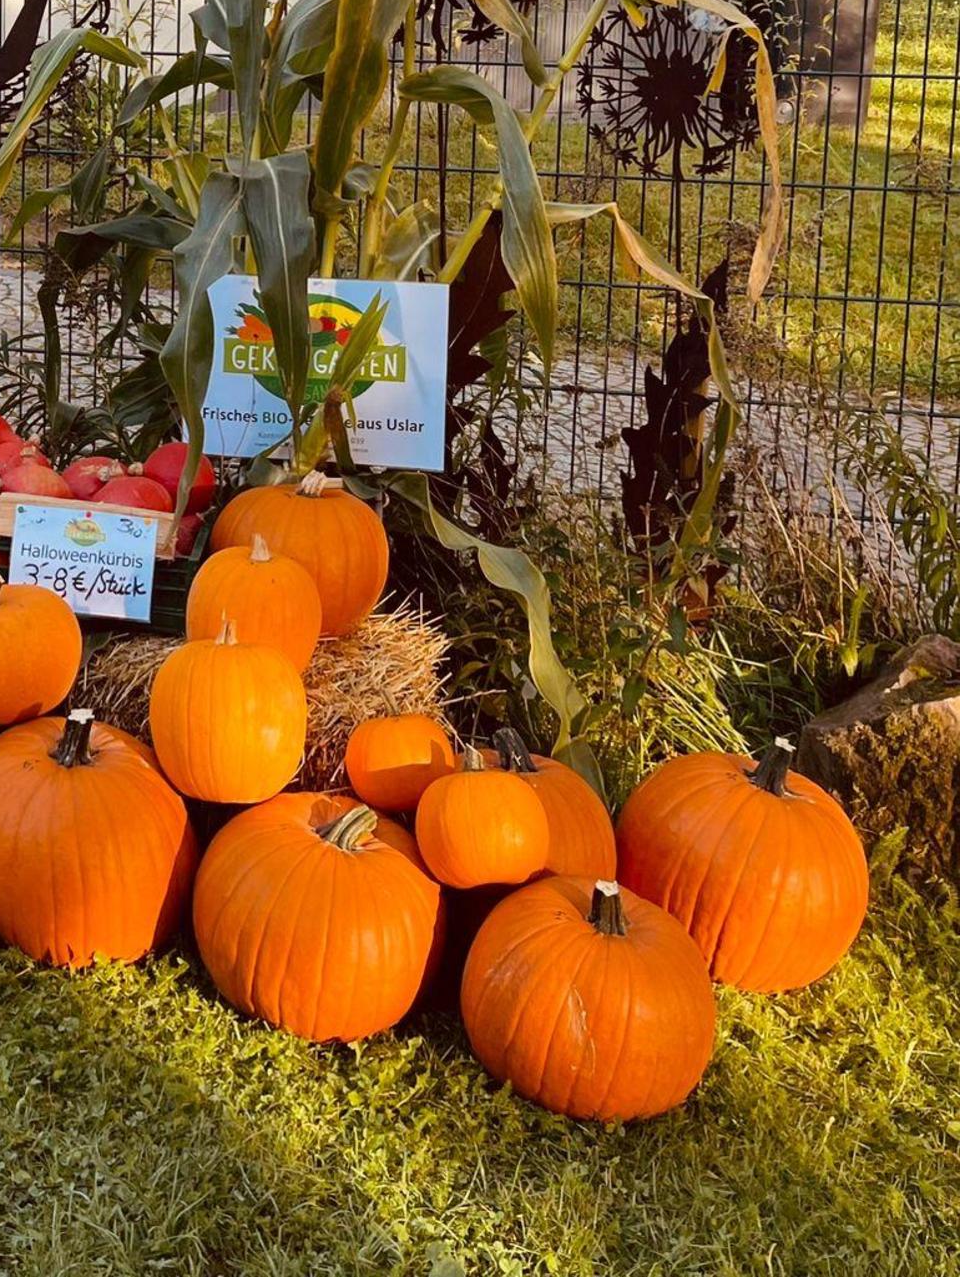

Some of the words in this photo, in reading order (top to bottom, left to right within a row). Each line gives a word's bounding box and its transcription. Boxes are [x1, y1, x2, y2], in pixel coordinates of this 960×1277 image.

[231, 344, 277, 372] GEK
[313, 348, 398, 378] GATEN
[202, 407, 258, 424] Frisches
[357, 419, 382, 431] aus
[387, 418, 425, 433] Uslar
[20, 543, 144, 569] Halloweenkürbis
